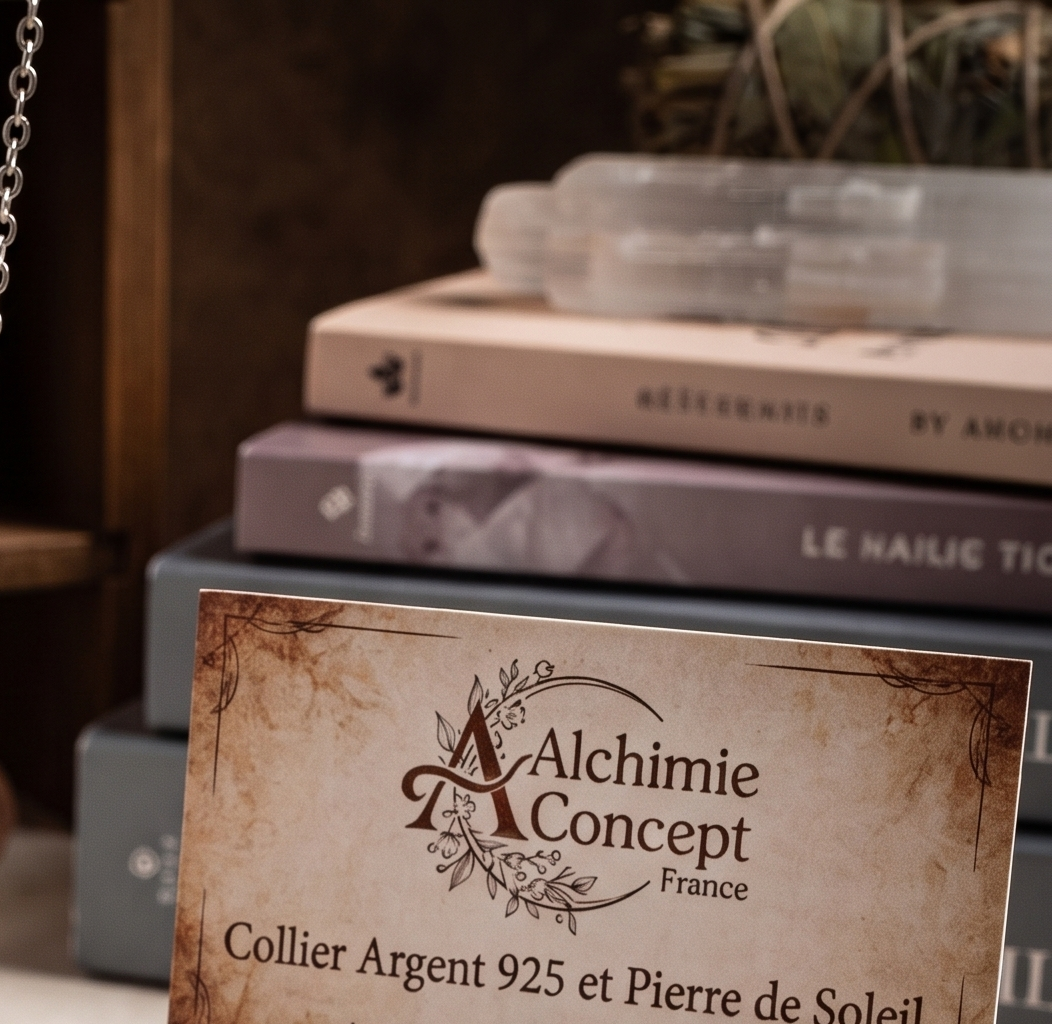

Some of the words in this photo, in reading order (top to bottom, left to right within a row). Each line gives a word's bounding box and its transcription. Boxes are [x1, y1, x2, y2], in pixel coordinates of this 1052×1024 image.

[528, 727, 760, 798] Alchimie
[530, 791, 752, 871] Concept
[660, 867, 749, 901] France
[223, 921, 347, 971] Collier
[355, 936, 486, 993] Argent
[497, 953, 565, 997] 925
[577, 967, 614, 1002] et
[623, 966, 742, 1018] Pierre
[753, 979, 802, 1024] de
